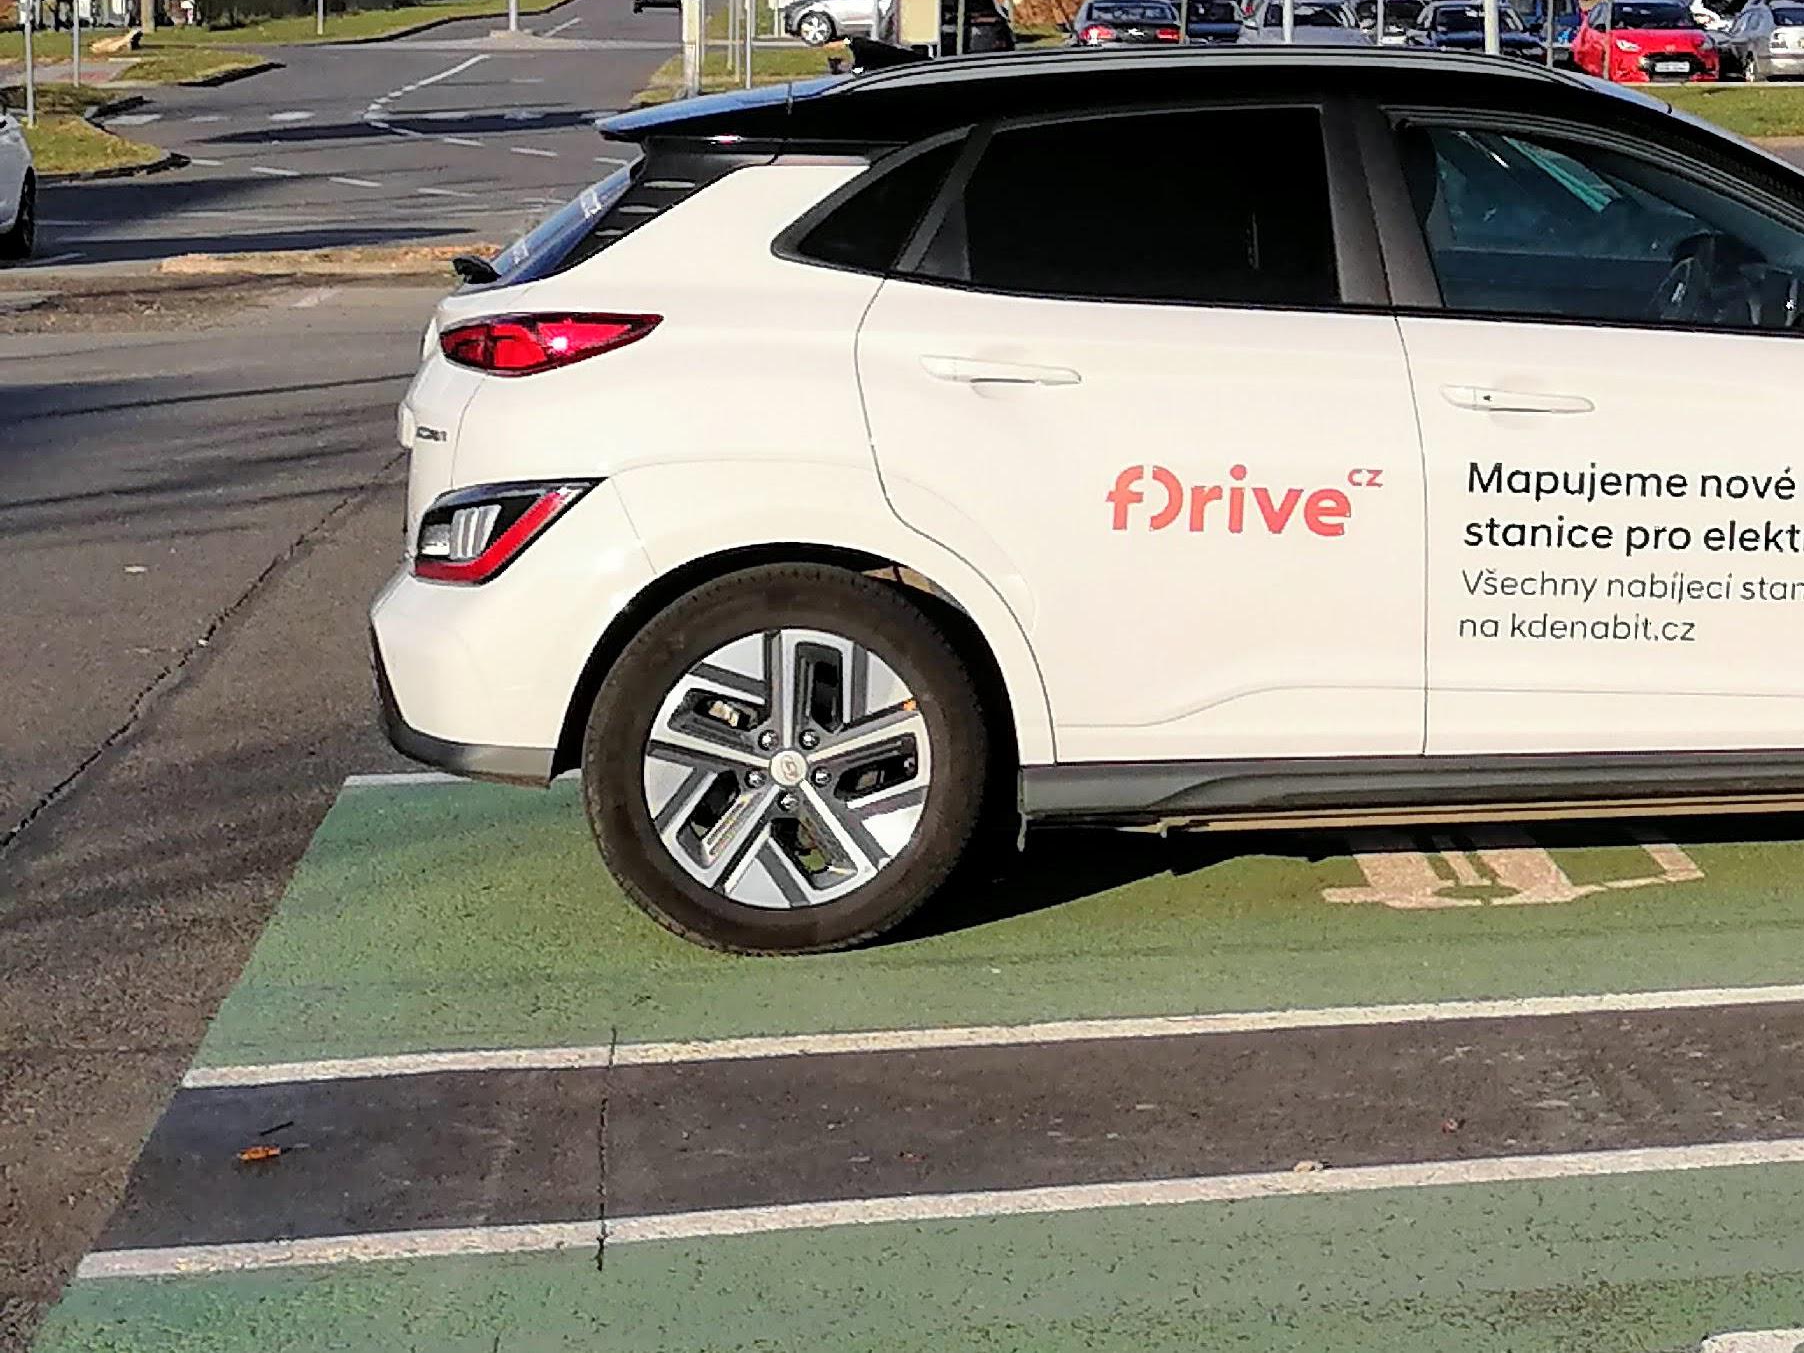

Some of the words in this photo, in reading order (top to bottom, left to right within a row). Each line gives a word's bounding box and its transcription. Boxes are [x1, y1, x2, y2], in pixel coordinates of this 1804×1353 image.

[1468, 462, 1688, 503] Mapujeme
[1701, 466, 1796, 500] nové
[1463, 515, 1614, 548] stanice
[1626, 524, 1692, 557] pro
[1462, 568, 1598, 603] Všechny
[1607, 571, 1733, 604] nabíjecí
[1459, 618, 1500, 638] na
[1510, 613, 1696, 642] kdenabit.cz
